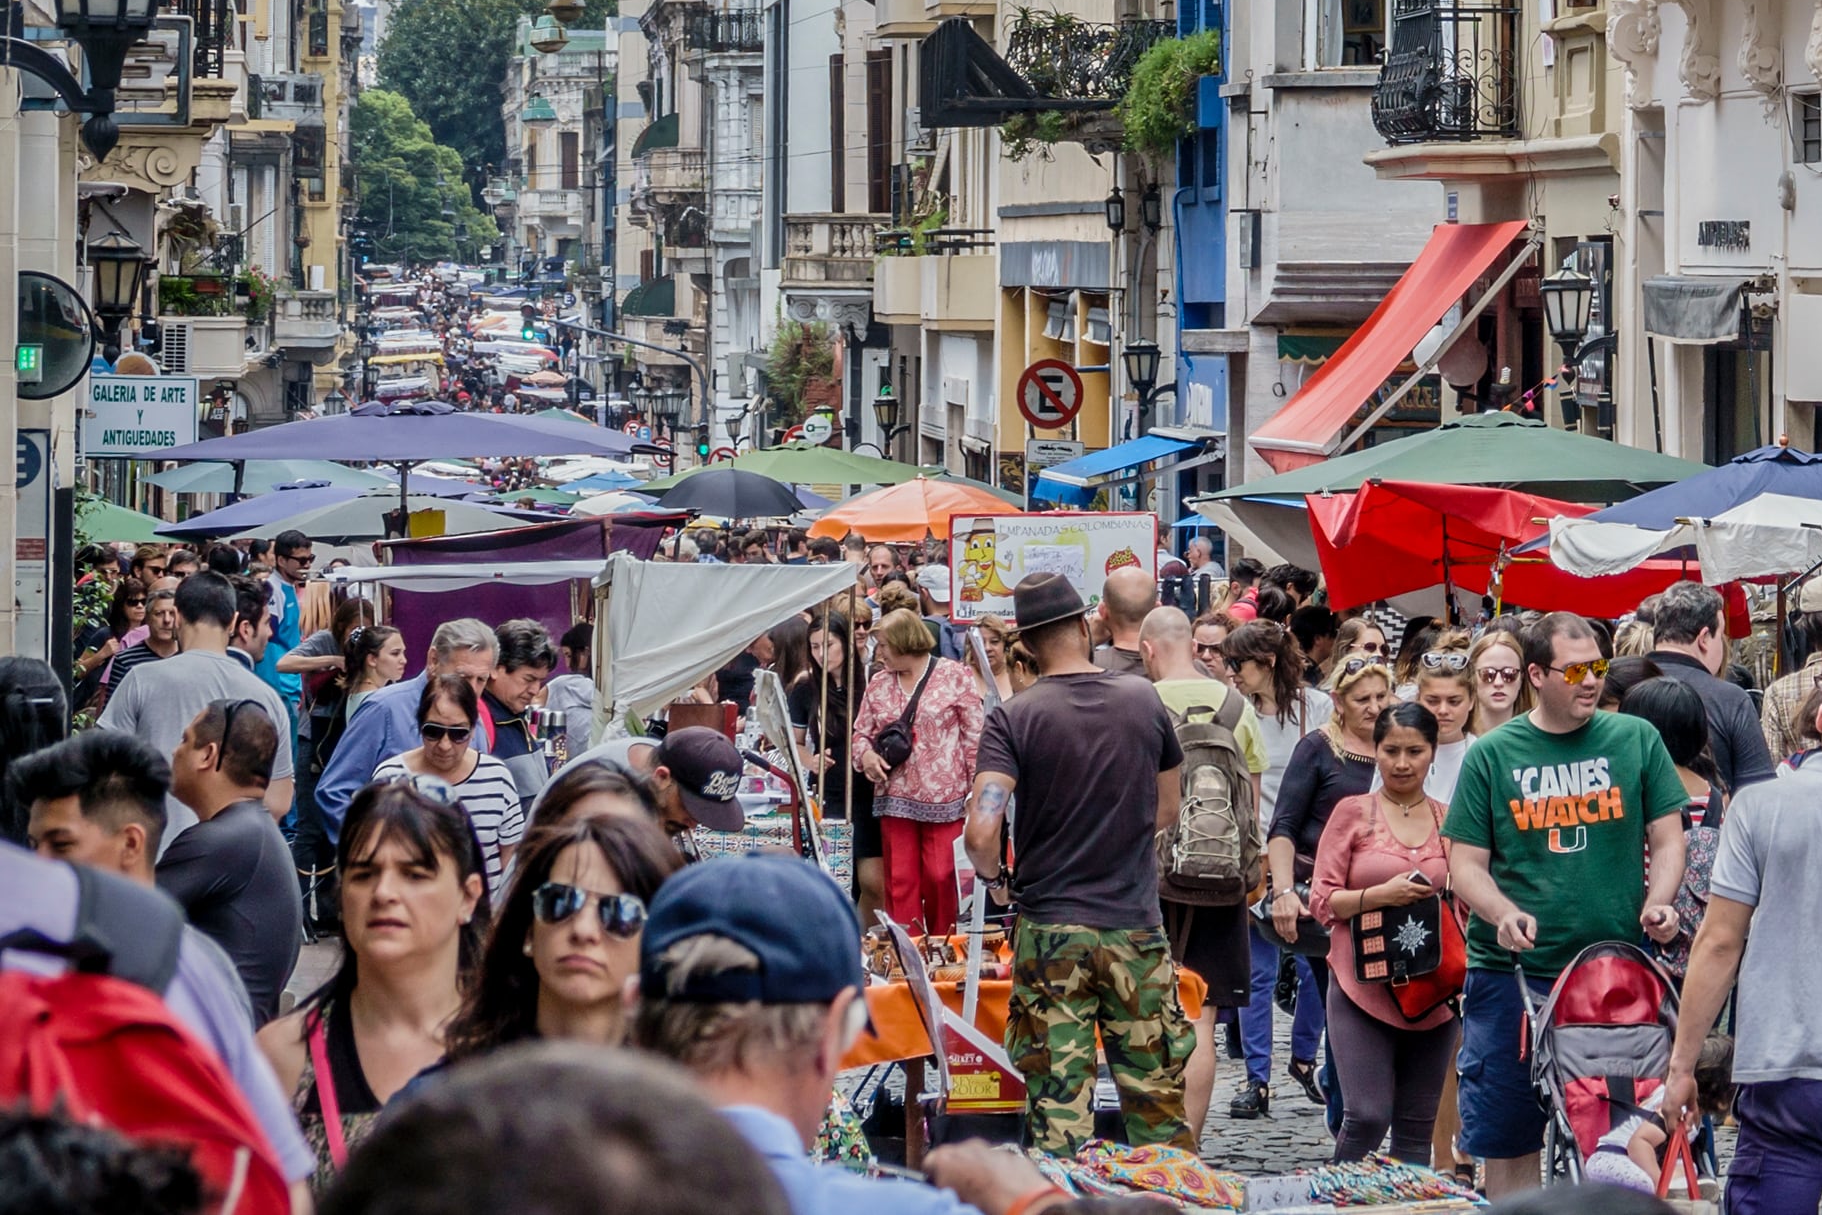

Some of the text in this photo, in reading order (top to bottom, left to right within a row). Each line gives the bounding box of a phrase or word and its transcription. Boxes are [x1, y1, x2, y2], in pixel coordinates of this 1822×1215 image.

[93, 385, 186, 403] GALERIA DE ARTE
[1039, 375, 1063, 413] E
[137, 409, 144, 425] Y
[102, 429, 176, 447] ANTIGUEDADES
[1069, 519, 1151, 532] COLOMBIANAS
[1509, 786, 1624, 831] WATCH
[1548, 826, 1587, 853] U
